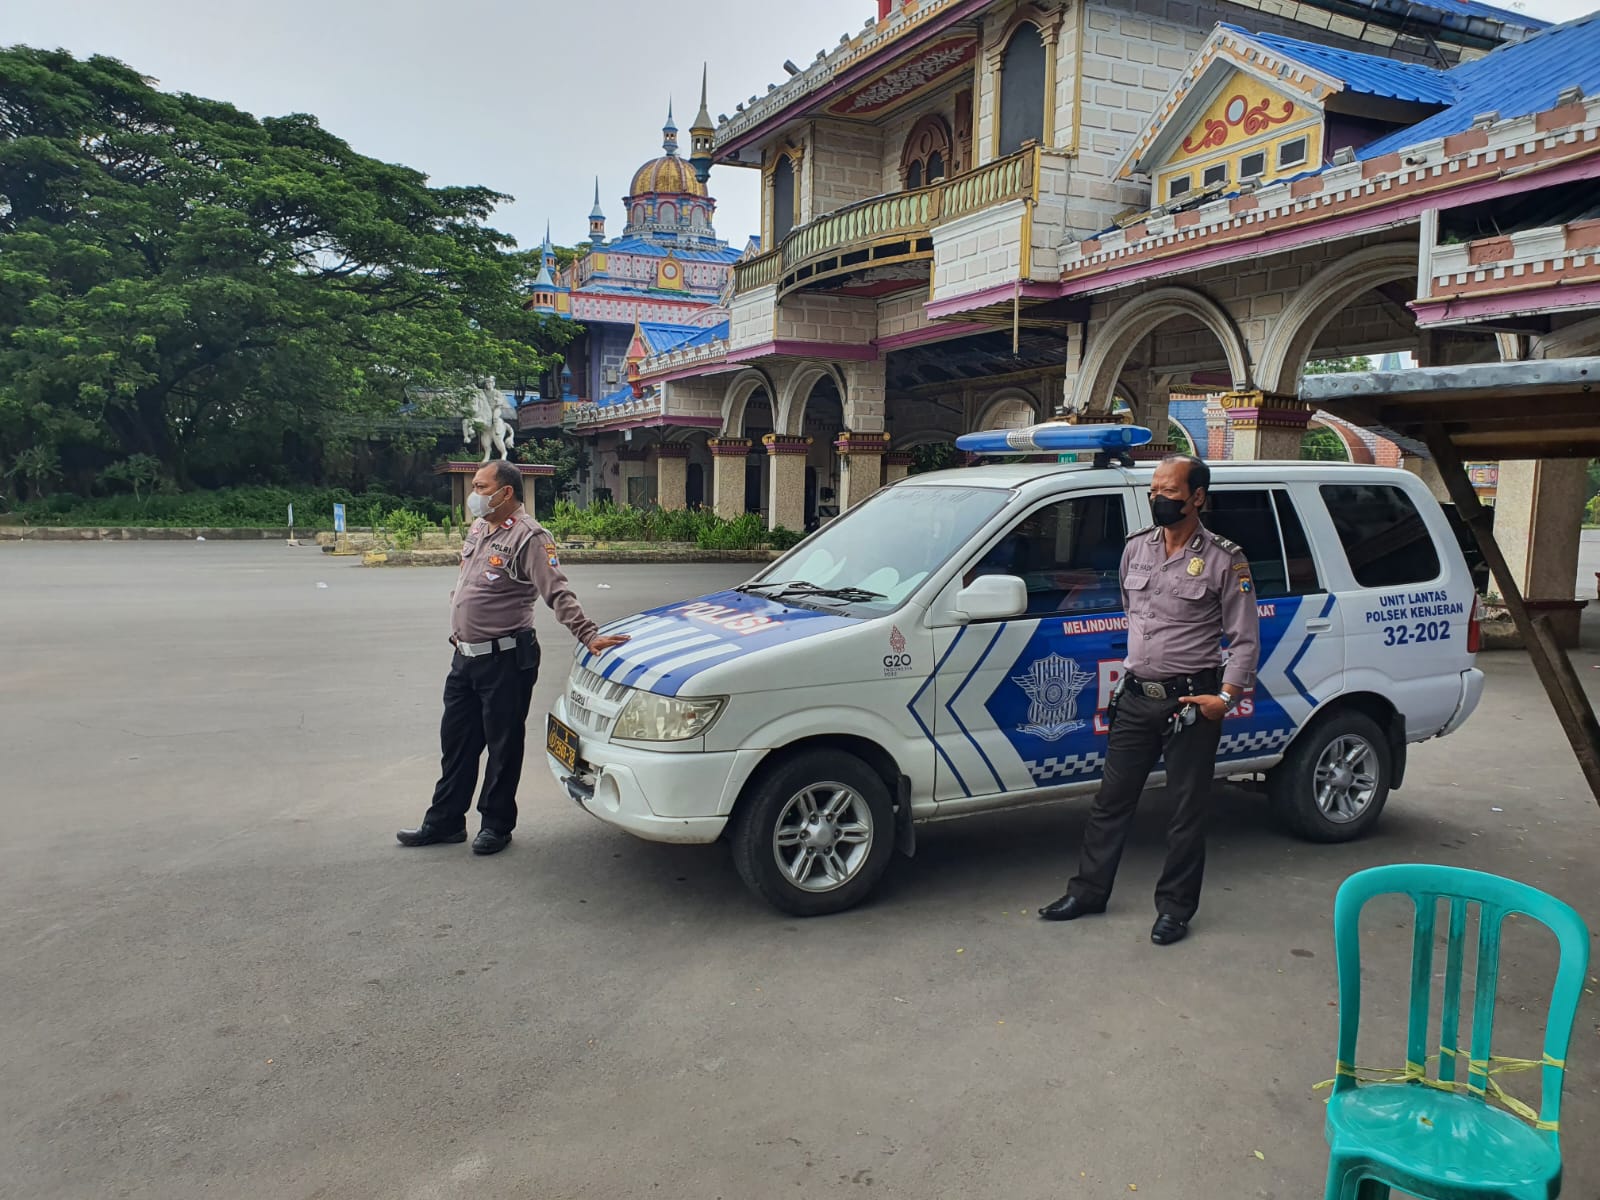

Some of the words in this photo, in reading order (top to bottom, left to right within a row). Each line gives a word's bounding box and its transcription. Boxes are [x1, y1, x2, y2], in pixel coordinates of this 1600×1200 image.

[491, 543, 512, 554] POLRI
[1379, 594, 1405, 607] UNIT
[1408, 590, 1447, 604] LANTAS
[667, 601, 784, 635] POLISI
[1366, 608, 1408, 623] POLSEK
[1410, 602, 1463, 618] KENJERAN
[1383, 620, 1451, 646] 32-202
